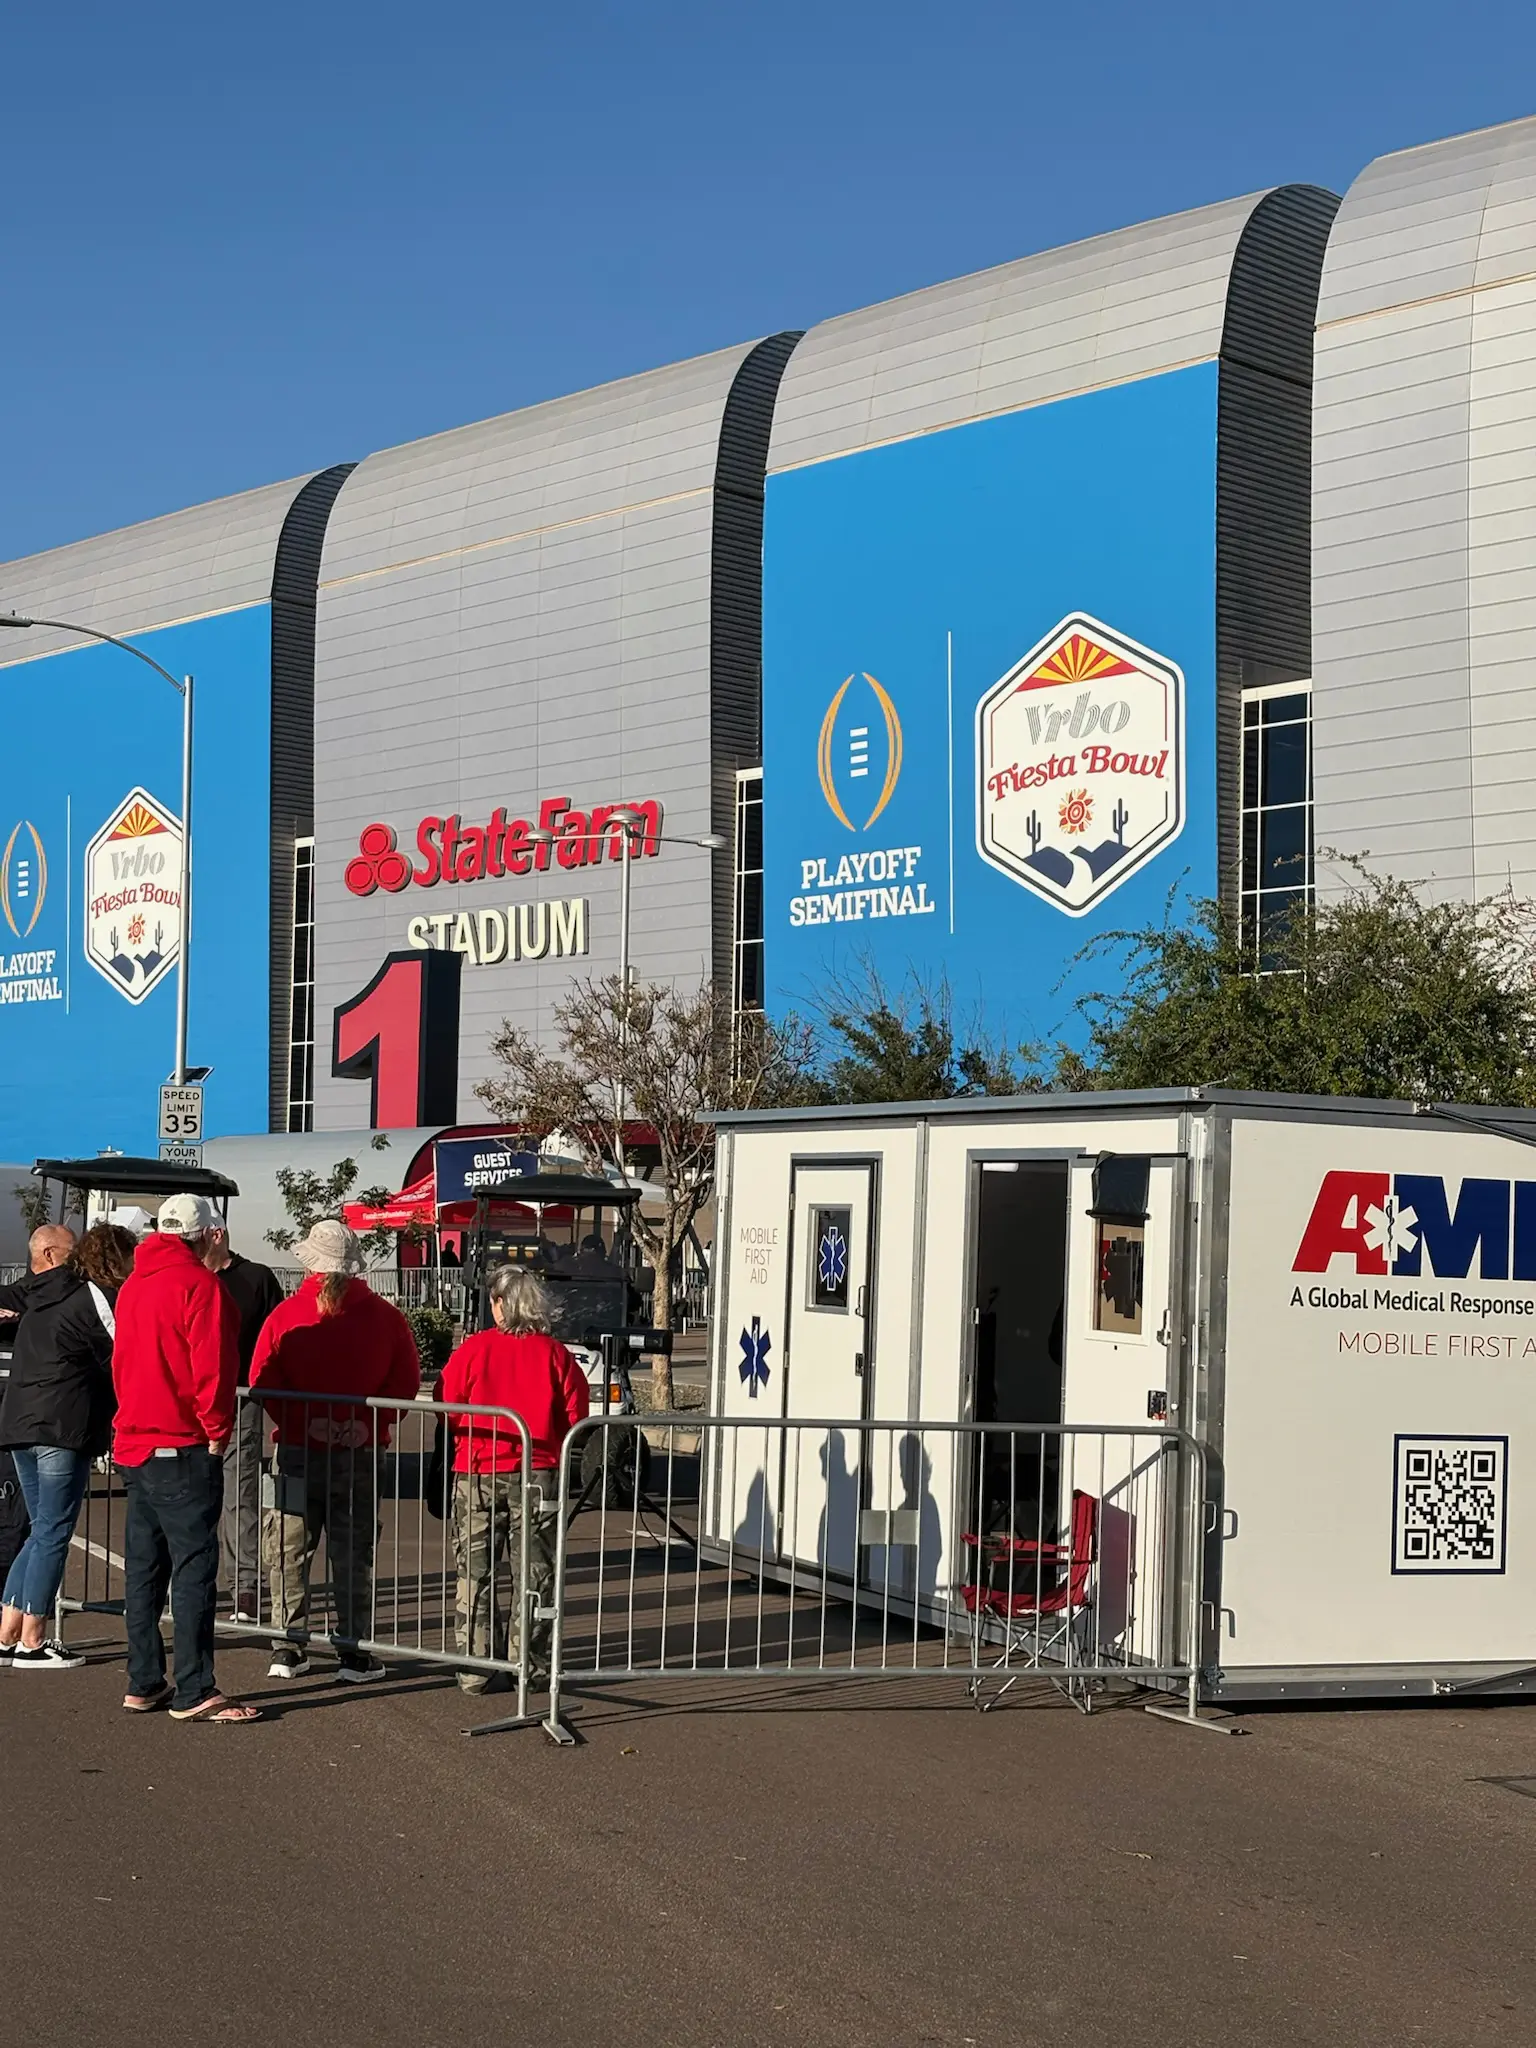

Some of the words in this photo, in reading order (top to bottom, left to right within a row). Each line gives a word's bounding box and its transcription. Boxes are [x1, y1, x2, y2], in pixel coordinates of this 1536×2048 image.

[1025, 691, 1131, 745] Vrbo
[988, 754, 1077, 801] Fiesta
[1081, 745, 1169, 779] Bowl
[111, 844, 165, 880] Vrbo
[801, 846, 921, 889] PLAYOFF
[91, 887, 138, 919] Fiesta
[789, 883, 935, 926] SEMIFINAL
[408, 898, 588, 965] STADIUM
[0, 950, 56, 977] LAYOFF
[0, 977, 62, 1004] MIFINAL
[333, 950, 430, 1128] 1
[164, 1091, 200, 1100] SPEED
[167, 1103, 195, 1113] LIMIT
[165, 1114, 198, 1133] 35
[166, 1148, 196, 1157] YOUR
[473, 1152, 511, 1169] GUEST
[740, 1227, 778, 1244] MOBILE
[1291, 1170, 1536, 1281] AM
[745, 1248, 772, 1266] FIRST
[750, 1267, 768, 1285] AID
[1290, 1286, 1304, 1307] A
[1308, 1287, 1368, 1309] Global
[1374, 1290, 1445, 1311] Medical
[1450, 1292, 1534, 1319] Response
[1338, 1331, 1438, 1355] MOBILE
[1448, 1335, 1517, 1358] FIRST
